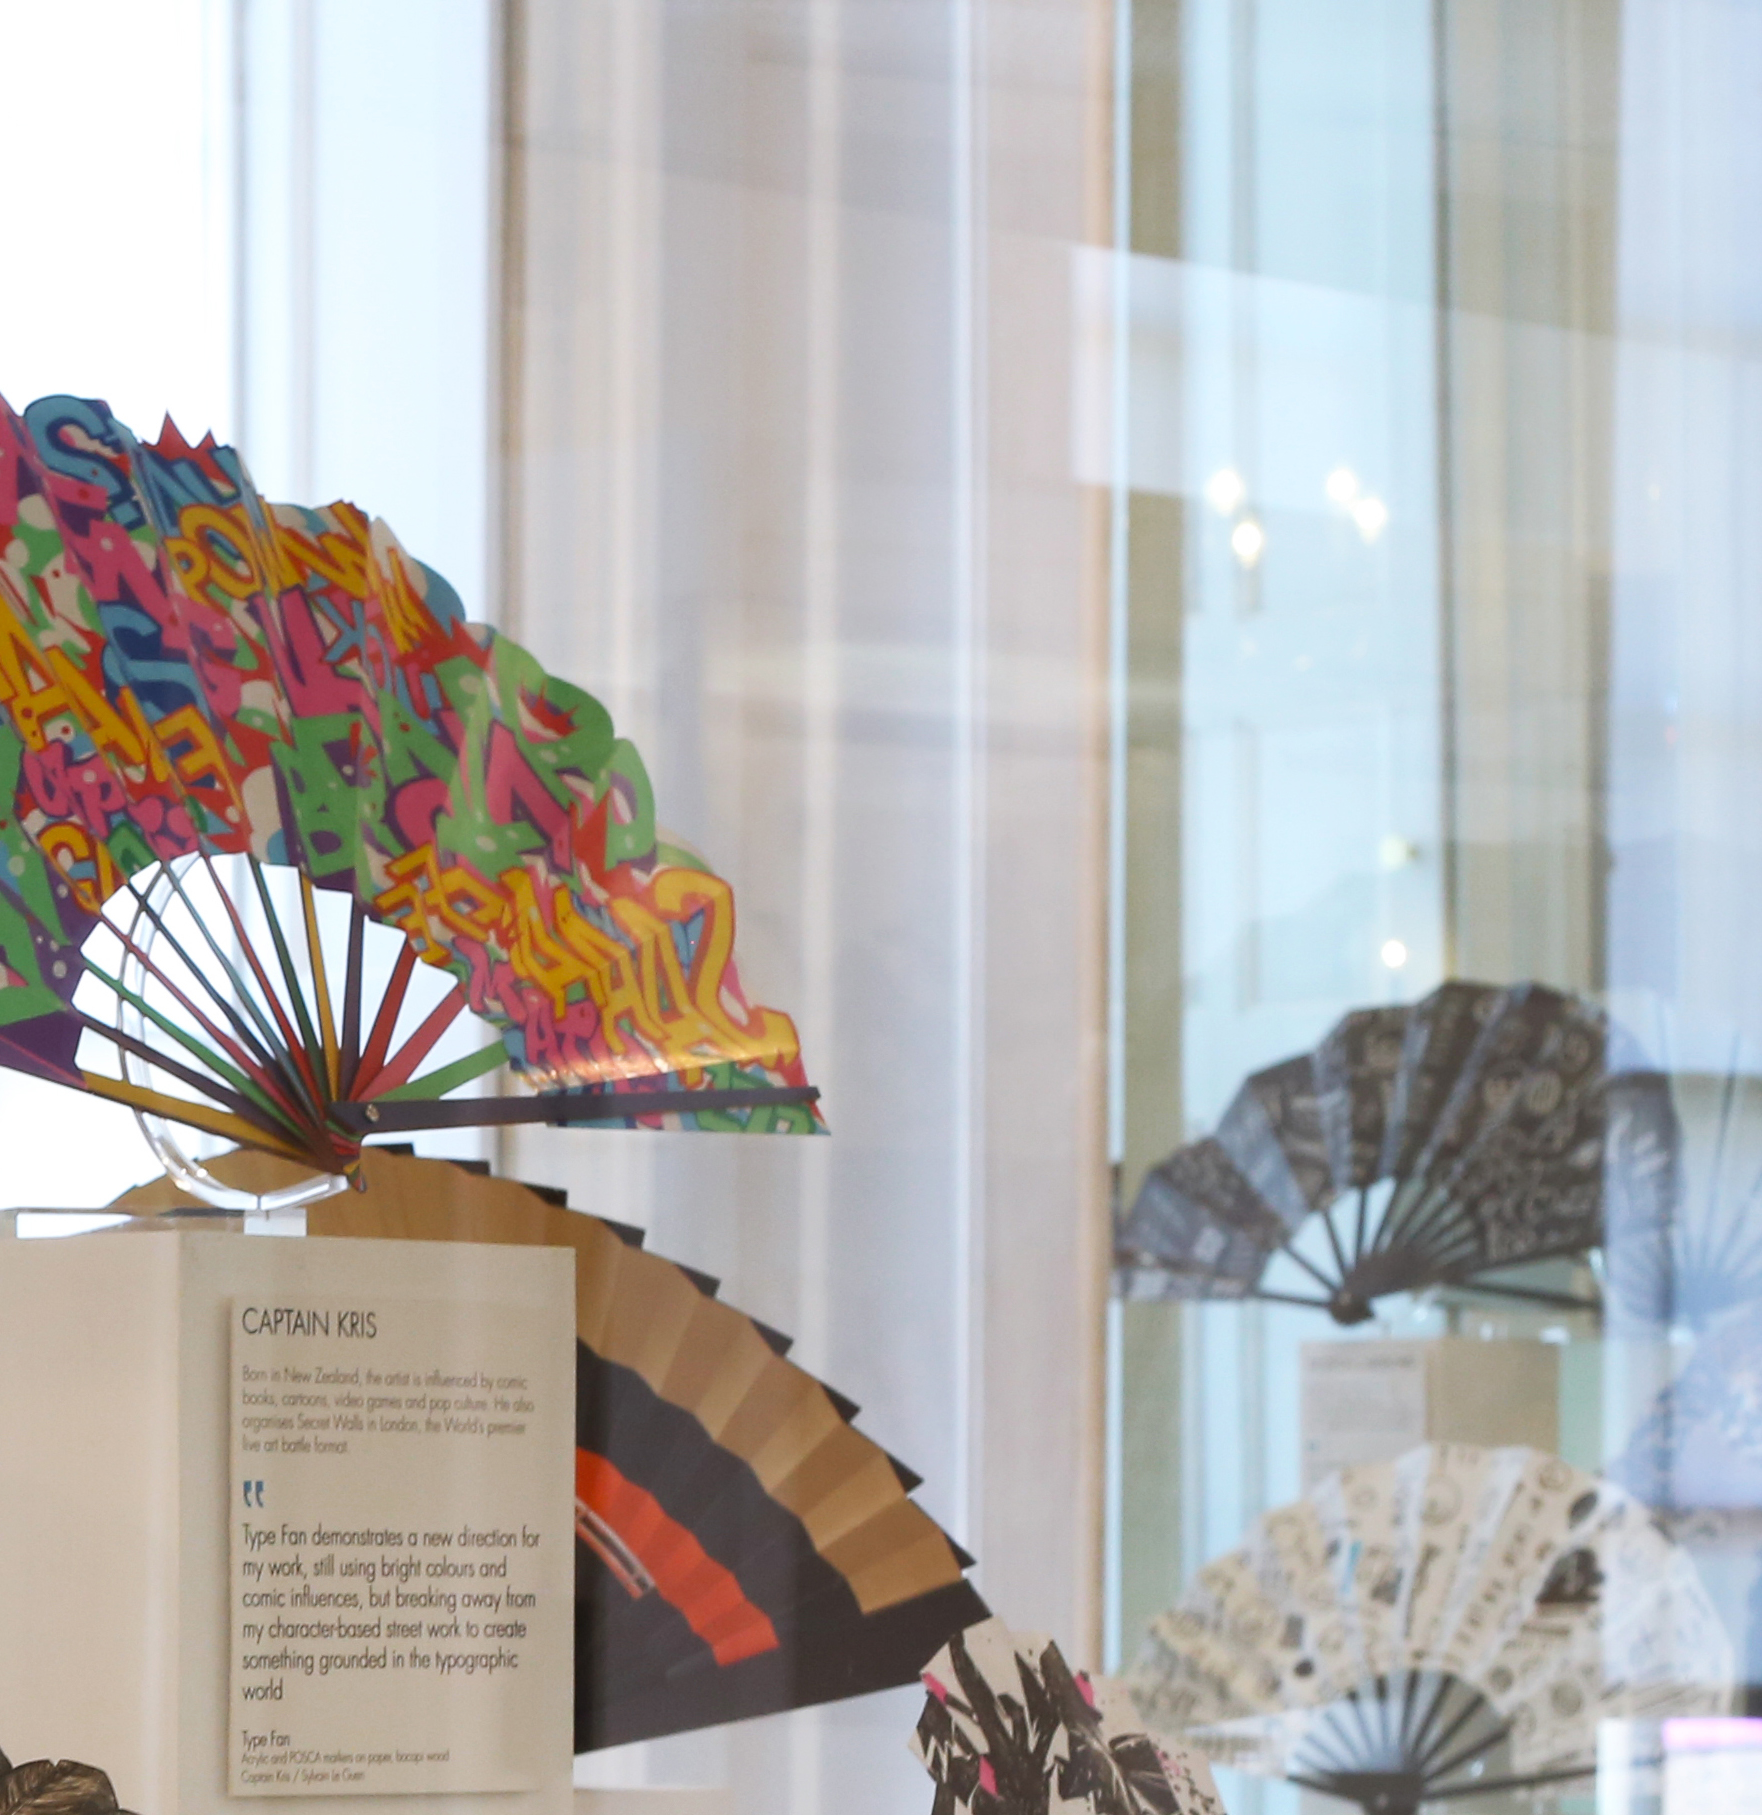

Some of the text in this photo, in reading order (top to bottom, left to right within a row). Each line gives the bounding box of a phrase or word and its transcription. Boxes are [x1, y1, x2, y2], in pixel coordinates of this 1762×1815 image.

[242, 1307, 377, 1339] CAPTAIN KRIS
[242, 1522, 540, 1552] Type Fan demonstrates a new direction for
[242, 1561, 264, 1582] my
[313, 1553, 335, 1577] still
[339, 1558, 376, 1584] using
[381, 1554, 421, 1584] bright
[425, 1555, 475, 1578] colours
[479, 1555, 507, 1578] and
[242, 1588, 285, 1608] comic
[369, 1582, 391, 1608] but
[395, 1584, 457, 1614] breaking
[461, 1593, 502, 1614] away
[505, 1585, 536, 1609] from
[242, 1623, 264, 1645] my
[386, 1620, 422, 1638] street
[427, 1615, 461, 1638] work
[465, 1620, 479, 1638] to
[483, 1620, 527, 1638] create
[242, 1646, 518, 1676] something grounded in the typographic
